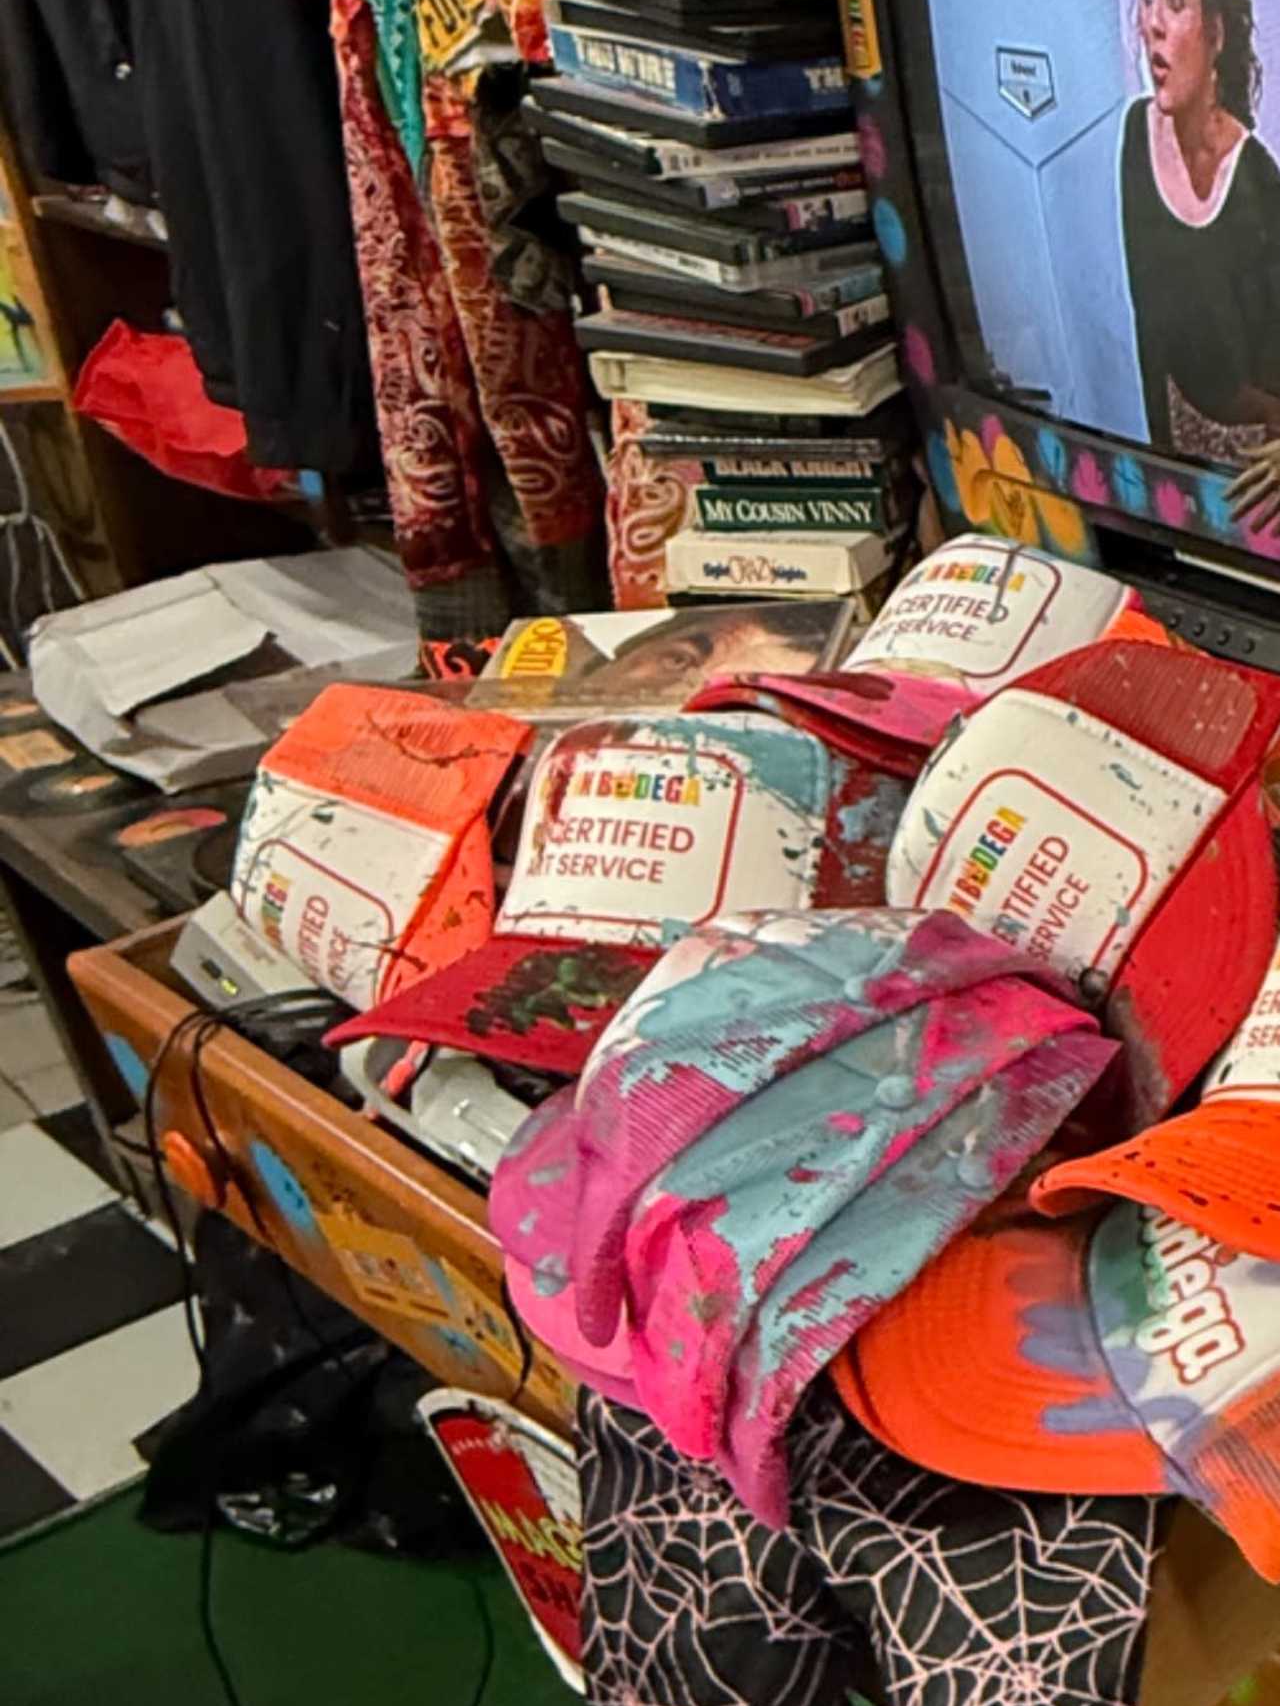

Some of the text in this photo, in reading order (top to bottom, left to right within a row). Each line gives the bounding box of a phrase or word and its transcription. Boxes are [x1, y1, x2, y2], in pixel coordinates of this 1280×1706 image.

[577, 34, 677, 94] THE WIRE
[704, 498, 873, 525] MY COUSIN VINNY
[896, 593, 1009, 624] CERTIFIED
[895, 619, 979, 643] SERVICE
[549, 816, 696, 854] CERTIFIED
[556, 853, 667, 885] SERVICE
[992, 834, 1071, 947] ERTIFIED
[1025, 871, 1091, 962] SERVICE
